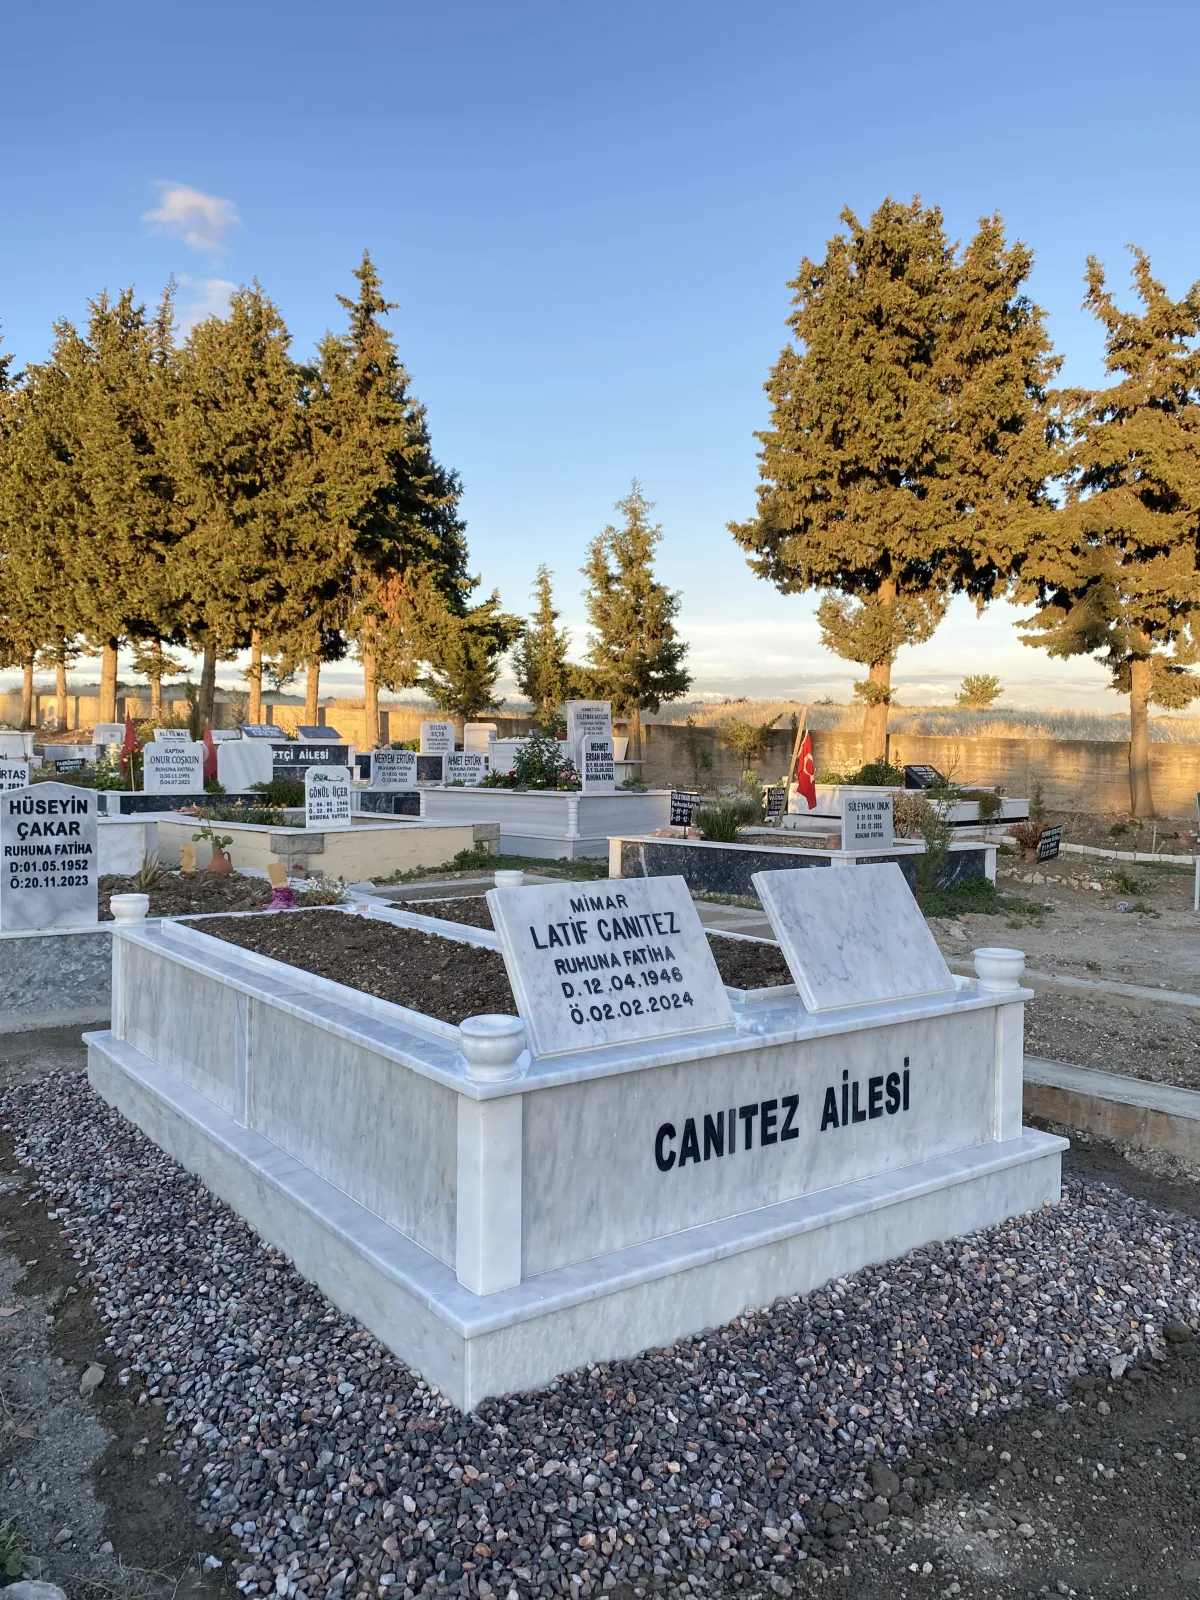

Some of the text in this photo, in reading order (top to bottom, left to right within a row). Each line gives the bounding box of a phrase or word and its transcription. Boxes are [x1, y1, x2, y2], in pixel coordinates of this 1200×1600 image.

[590, 742, 609, 751] MEHMET
[150, 755, 200, 766] ONUR COŞKUN
[299, 748, 329, 760] AİLESİ
[374, 752, 416, 764] MERYEM ERTÜRK
[447, 754, 482, 766] AHMET ERTÜRK
[586, 751, 614, 762] ERSAN BİROL
[309, 786, 348, 799] GÖNÜL ÜÇER
[9, 795, 88, 815] HÜSEYİN
[848, 801, 890, 811] SÜLEYMAN ONUK
[17, 821, 81, 841] ÇAKAR
[4, 841, 93, 857] RUHUNA FATİHA
[10, 860, 88, 873] D:01.05.1952
[10, 875, 89, 889] Ö:20.11.2023
[569, 893, 629, 913] MİMAR
[529, 911, 681, 950] LATİF CANITEZ
[554, 944, 676, 976] RUHUNA FATİHA
[569, 991, 694, 1025] Ö.02.02.2024
[654, 1056, 910, 1172] CANITEZ AİLESİ
